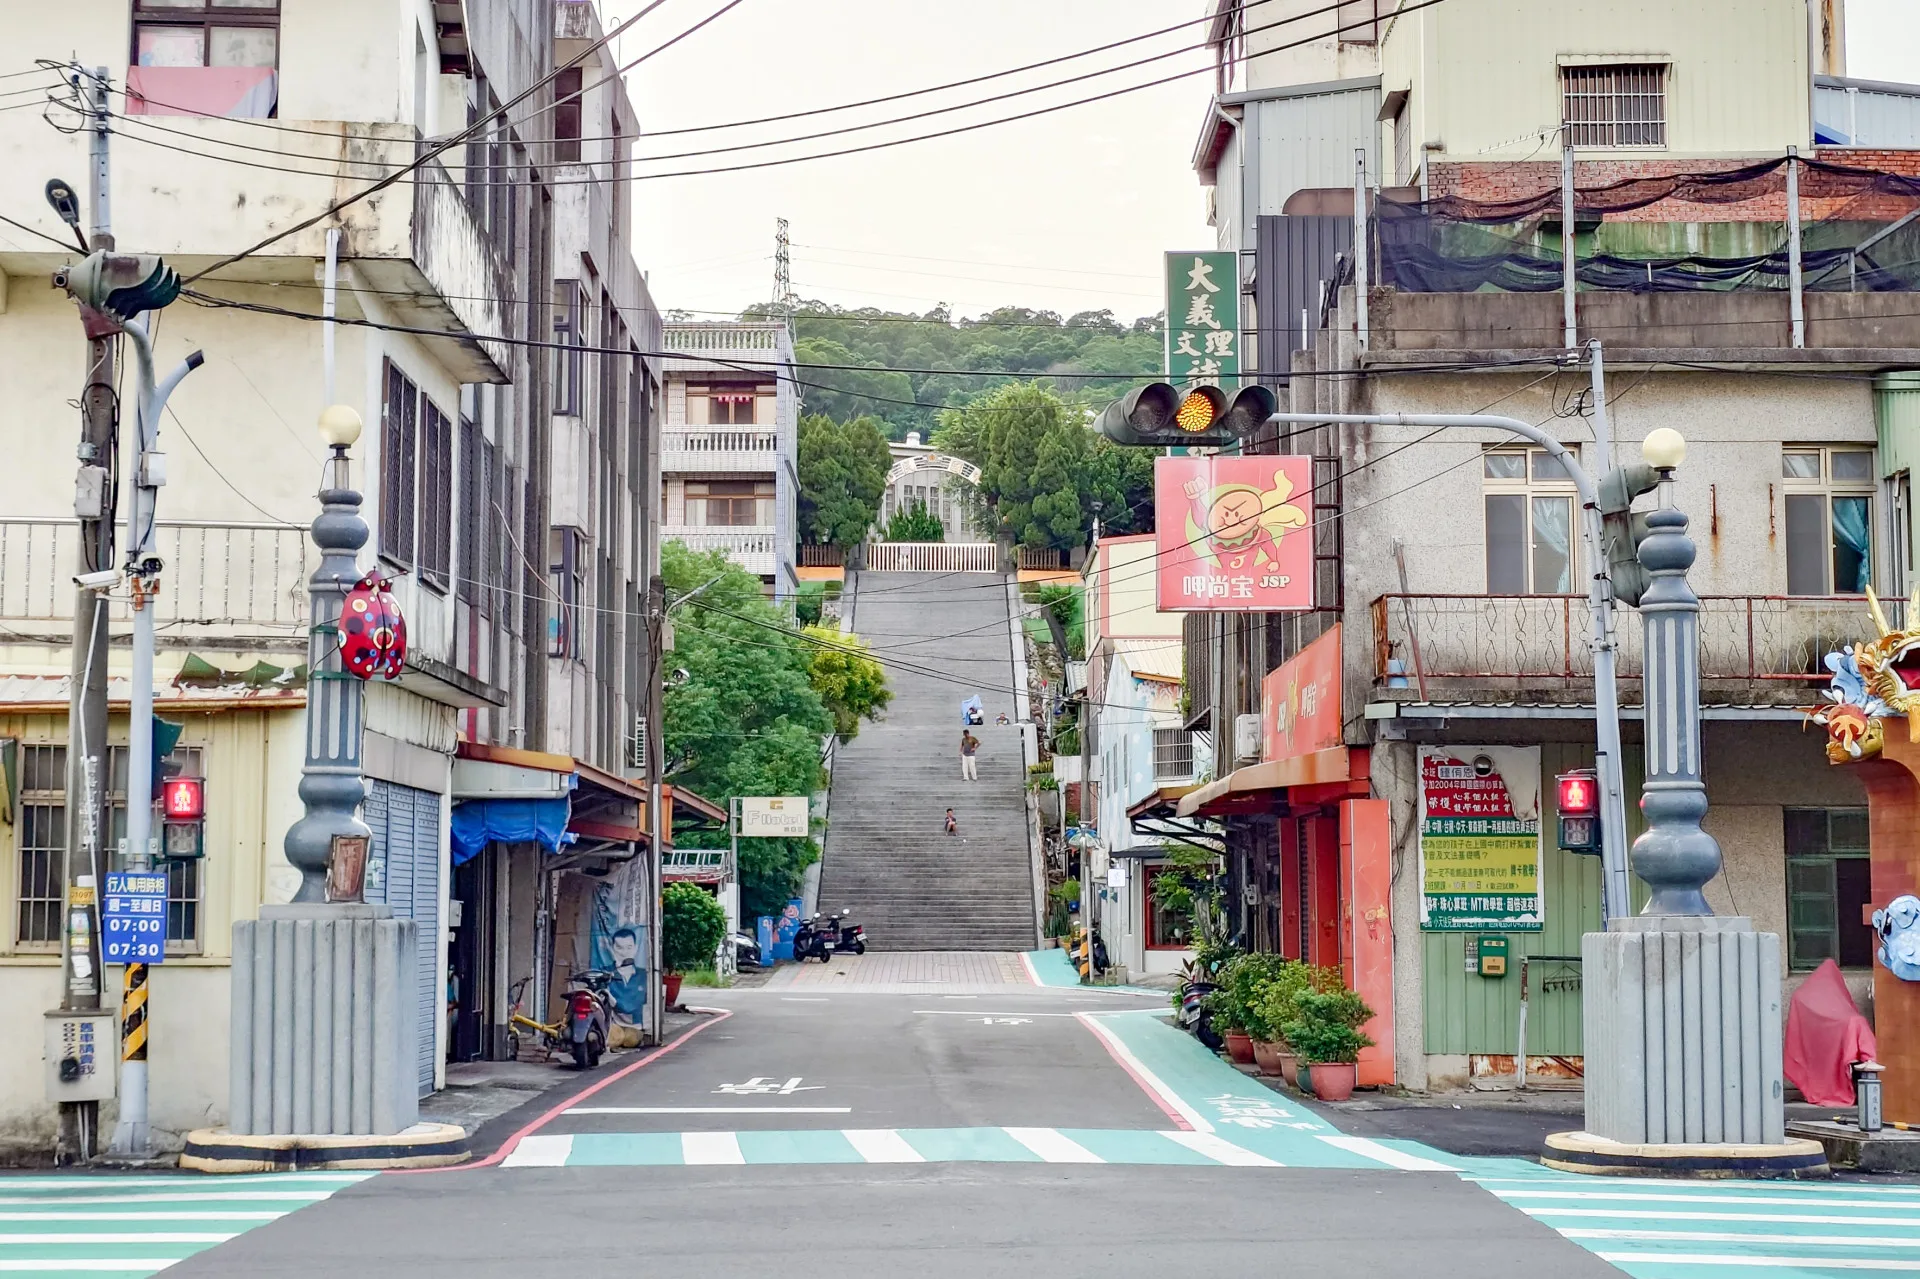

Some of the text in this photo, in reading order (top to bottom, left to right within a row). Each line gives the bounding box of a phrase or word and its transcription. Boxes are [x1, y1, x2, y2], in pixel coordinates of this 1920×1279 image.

[1182, 574, 1292, 599] 呷尚宝 JSP
[109, 919, 160, 932] 07:00
[108, 943, 159, 957] 07:30
